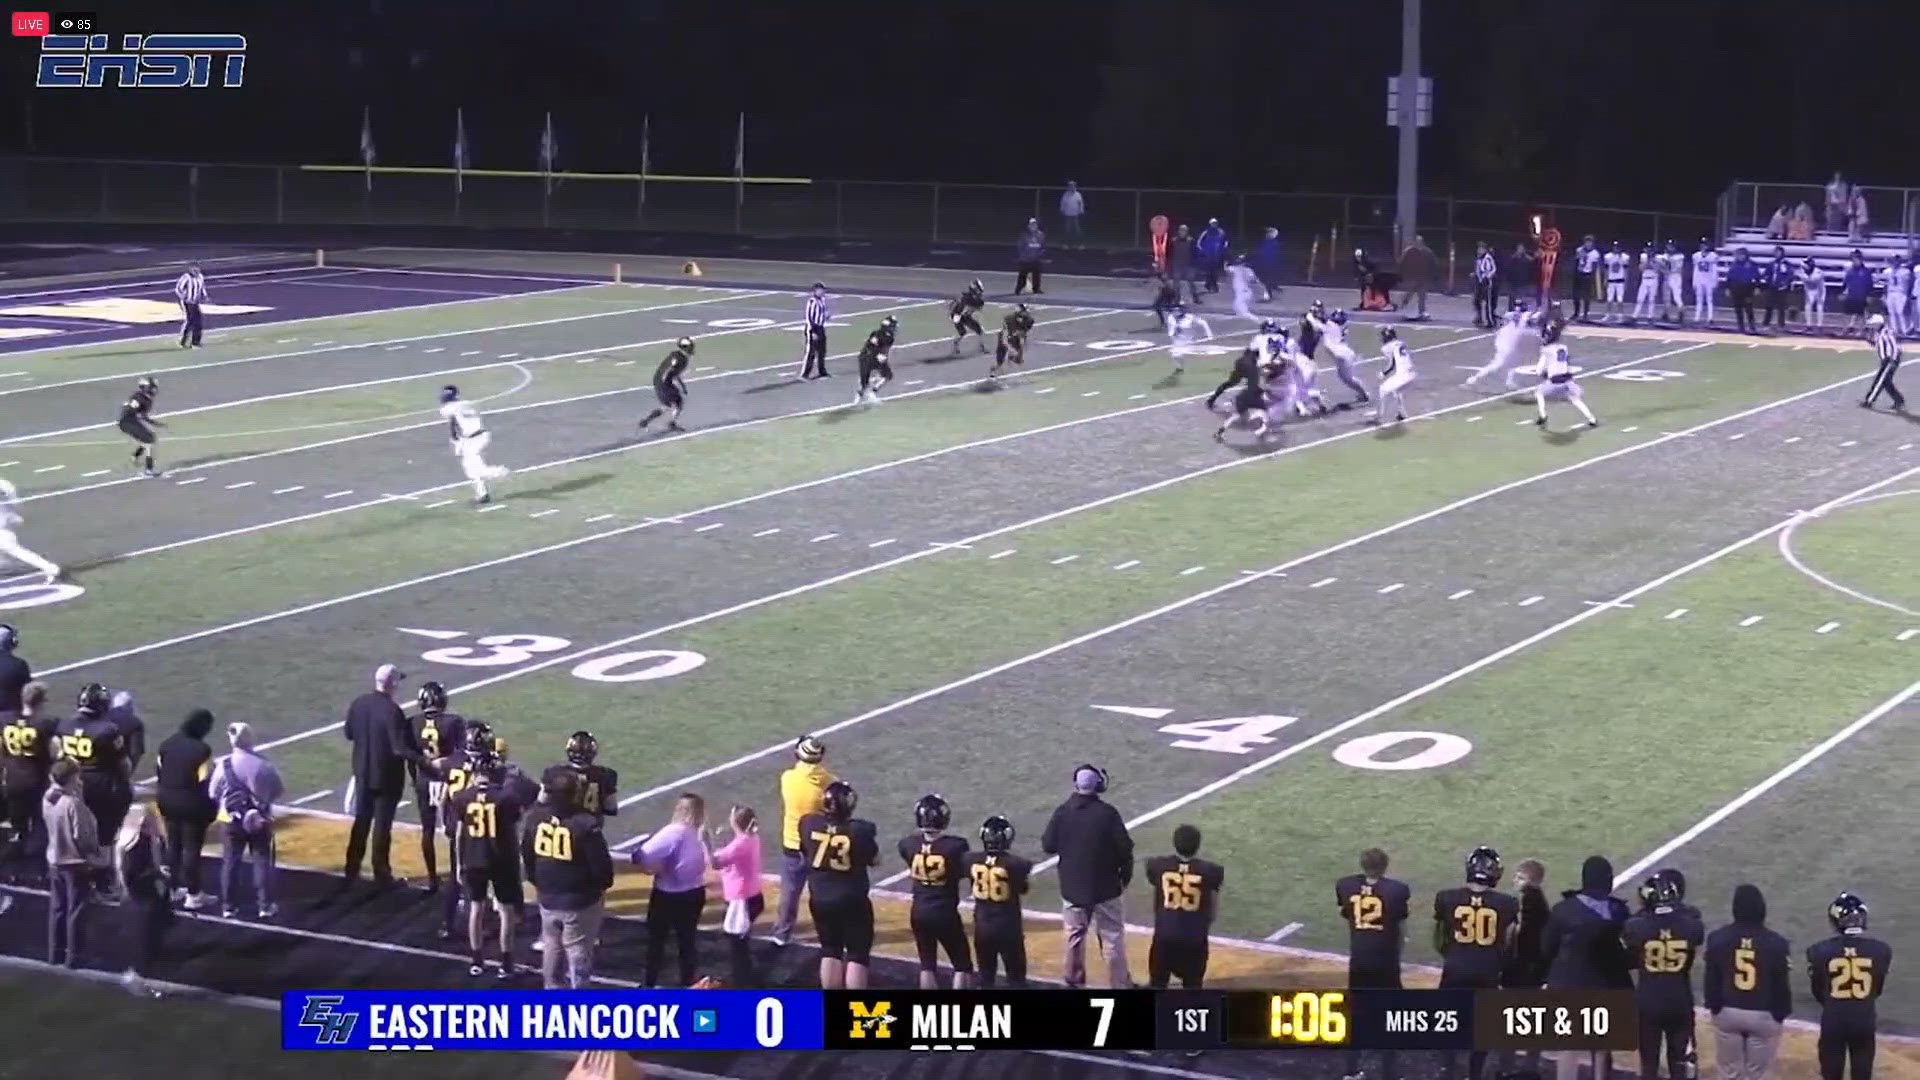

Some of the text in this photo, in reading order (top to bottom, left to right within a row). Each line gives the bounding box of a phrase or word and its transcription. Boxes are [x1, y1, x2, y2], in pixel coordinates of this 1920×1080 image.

[422, 727, 439, 759] 3
[449, 768, 475, 800] 2
[466, 802, 497, 838] 31
[534, 821, 572, 861] 60
[811, 831, 851, 871] 73
[911, 854, 946, 886] 42
[971, 864, 1009, 902] 86
[1161, 871, 1202, 912] 65
[1350, 894, 1383, 930] 12
[1454, 905, 1497, 946] 30
[1644, 939, 1688, 973] 85
[1734, 949, 1756, 991] 5
[1828, 957, 1872, 999] 25
